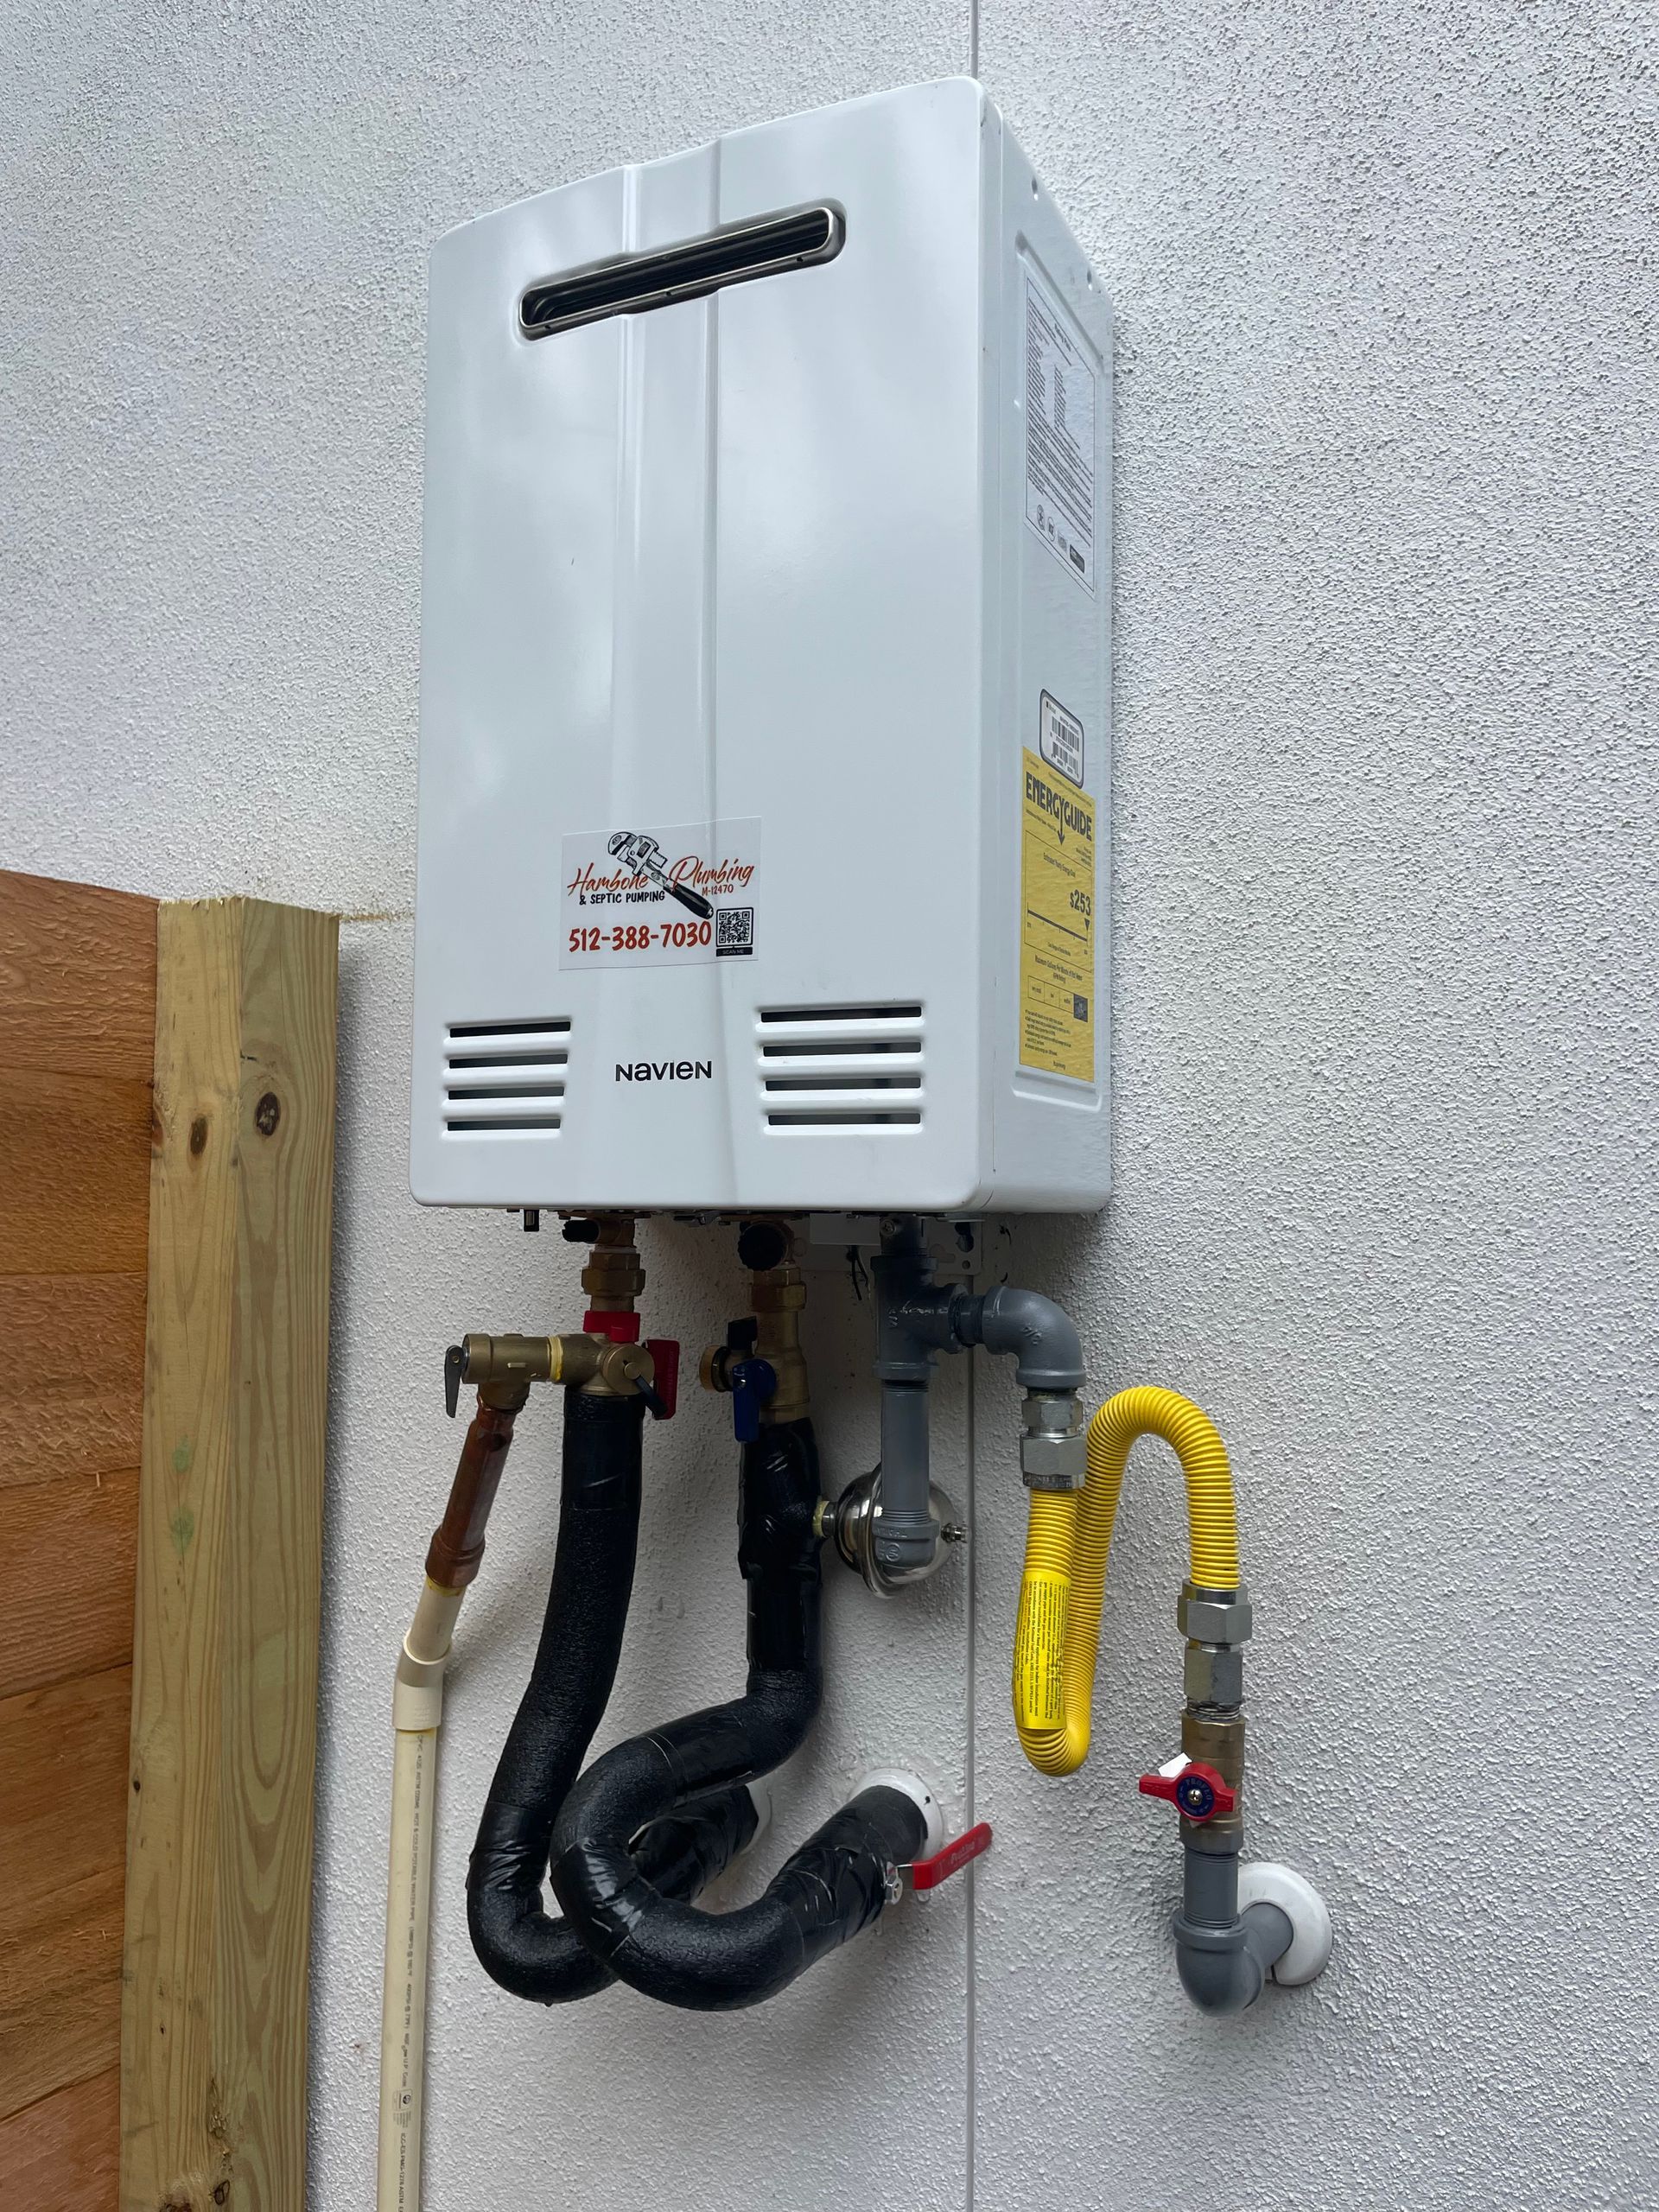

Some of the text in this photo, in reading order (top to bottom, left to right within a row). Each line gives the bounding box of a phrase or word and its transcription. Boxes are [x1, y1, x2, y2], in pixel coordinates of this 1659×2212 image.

[1026, 771, 1092, 842] ENERGYGUIDE
[567, 855, 754, 897] Hambone Plumbing
[702, 884, 734, 896] M-12470
[579, 890, 665, 906] & SEPTIC PUMPING
[1070, 888, 1091, 916] $253
[569, 921, 712, 952] 512-388-7030
